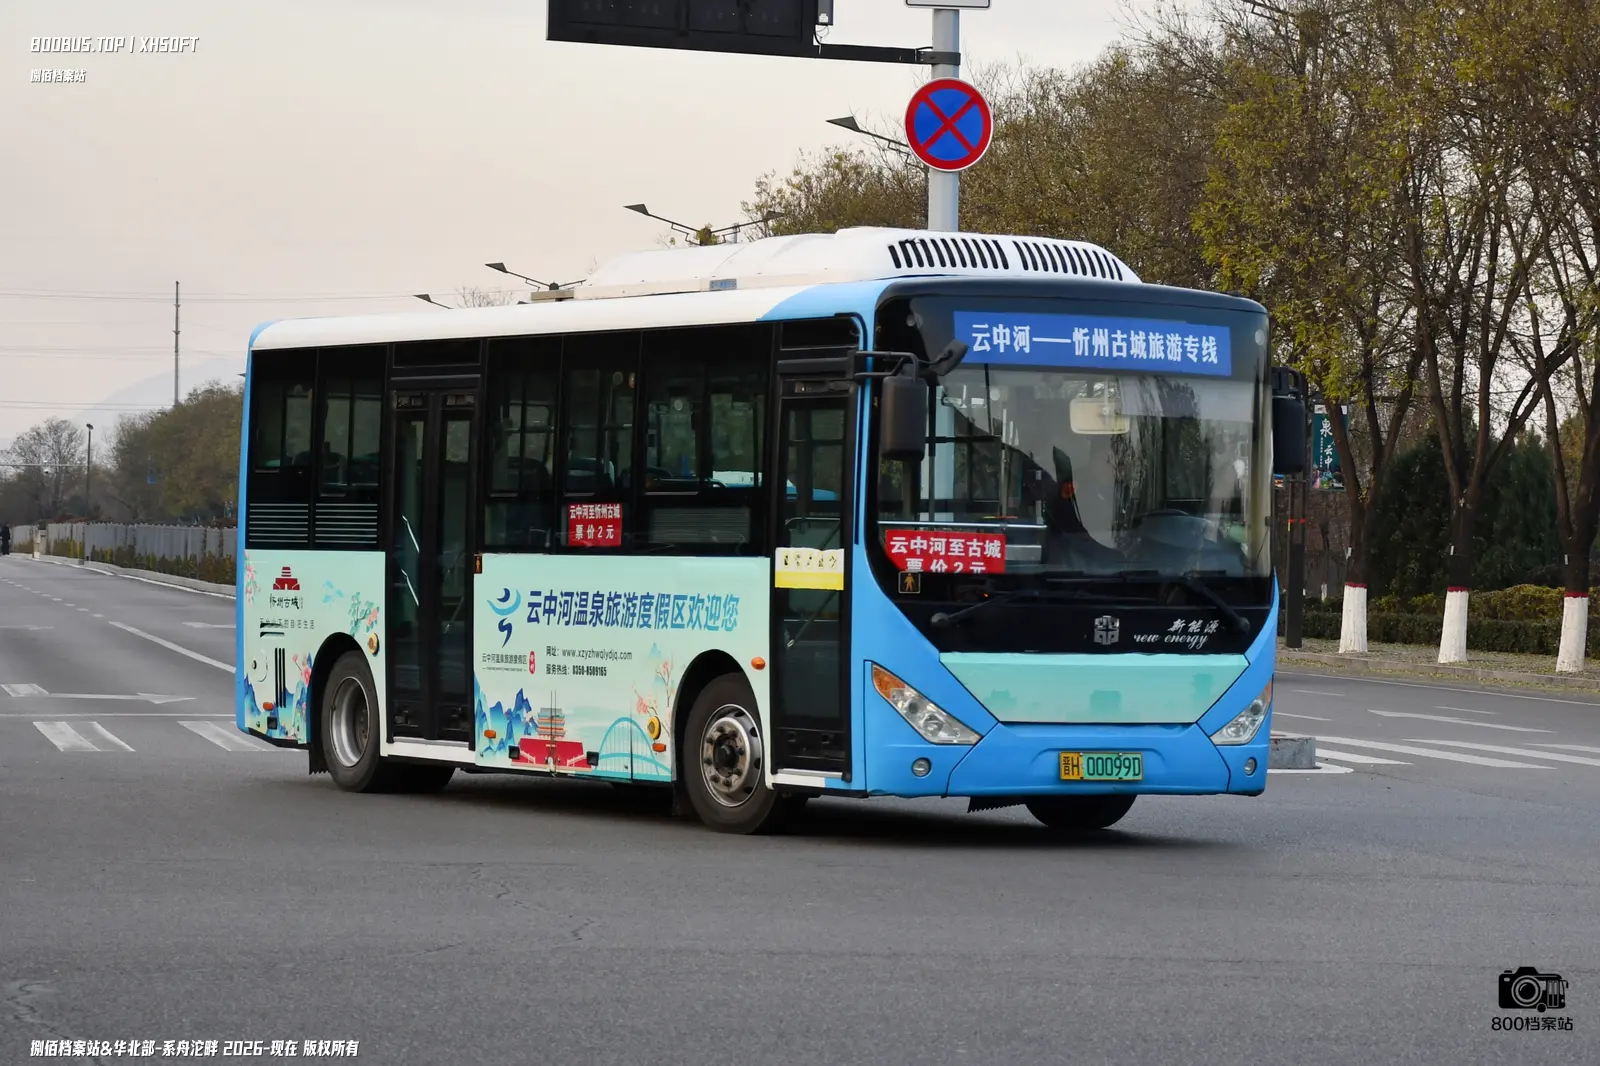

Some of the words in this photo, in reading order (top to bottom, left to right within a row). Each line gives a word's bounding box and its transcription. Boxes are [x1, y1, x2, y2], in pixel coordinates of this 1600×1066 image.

[971, 323, 1219, 365] 云中河——忻州古城旅游专线
[569, 503, 621, 519] 云中河至忻州古城
[890, 536, 1002, 559] 云中河至古城
[526, 589, 740, 632] 云中河温泉旅游度假区欢迎您
[1167, 618, 1219, 633] 新能源
[1133, 634, 1161, 643] new
[1164, 633, 1209, 650] energy
